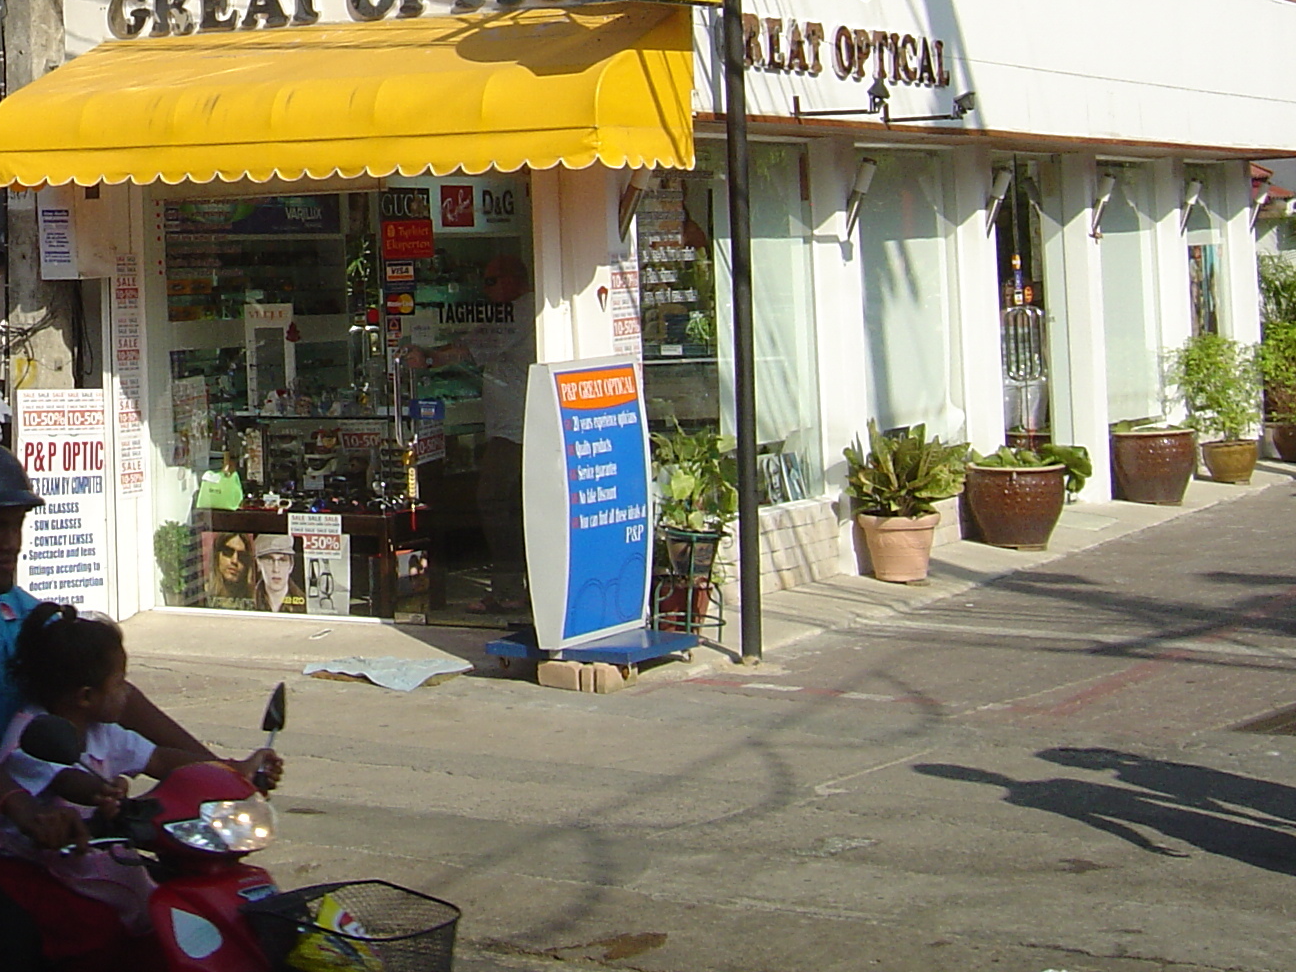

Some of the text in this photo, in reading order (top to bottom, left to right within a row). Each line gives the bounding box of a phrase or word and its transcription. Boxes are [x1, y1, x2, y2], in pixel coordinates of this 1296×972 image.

[716, 13, 950, 87] REAT OPTICAL
[483, 189, 514, 215] D&G
[117, 277, 136, 287] SALE
[118, 338, 138, 348] SALE
[561, 376, 635, 401] P&P GREAT OPTICAL
[120, 399, 139, 411] SALE
[24, 412, 65, 426] 10-50%
[63, 441, 103, 471] OPTIC
[122, 460, 141, 472] SALE
[42, 475, 102, 496] EXAM BY COMPUTER
[48, 502, 79, 515] GLASSES
[34, 518, 81, 531] SUN GLASSES
[34, 533, 93, 547] CONTACT LENSES
[626, 524, 644, 543] P&P
[29, 548, 64, 561] Spectacle
[66, 547, 79, 558] and
[56, 562, 92, 575] according
[59, 577, 103, 590] prescription
